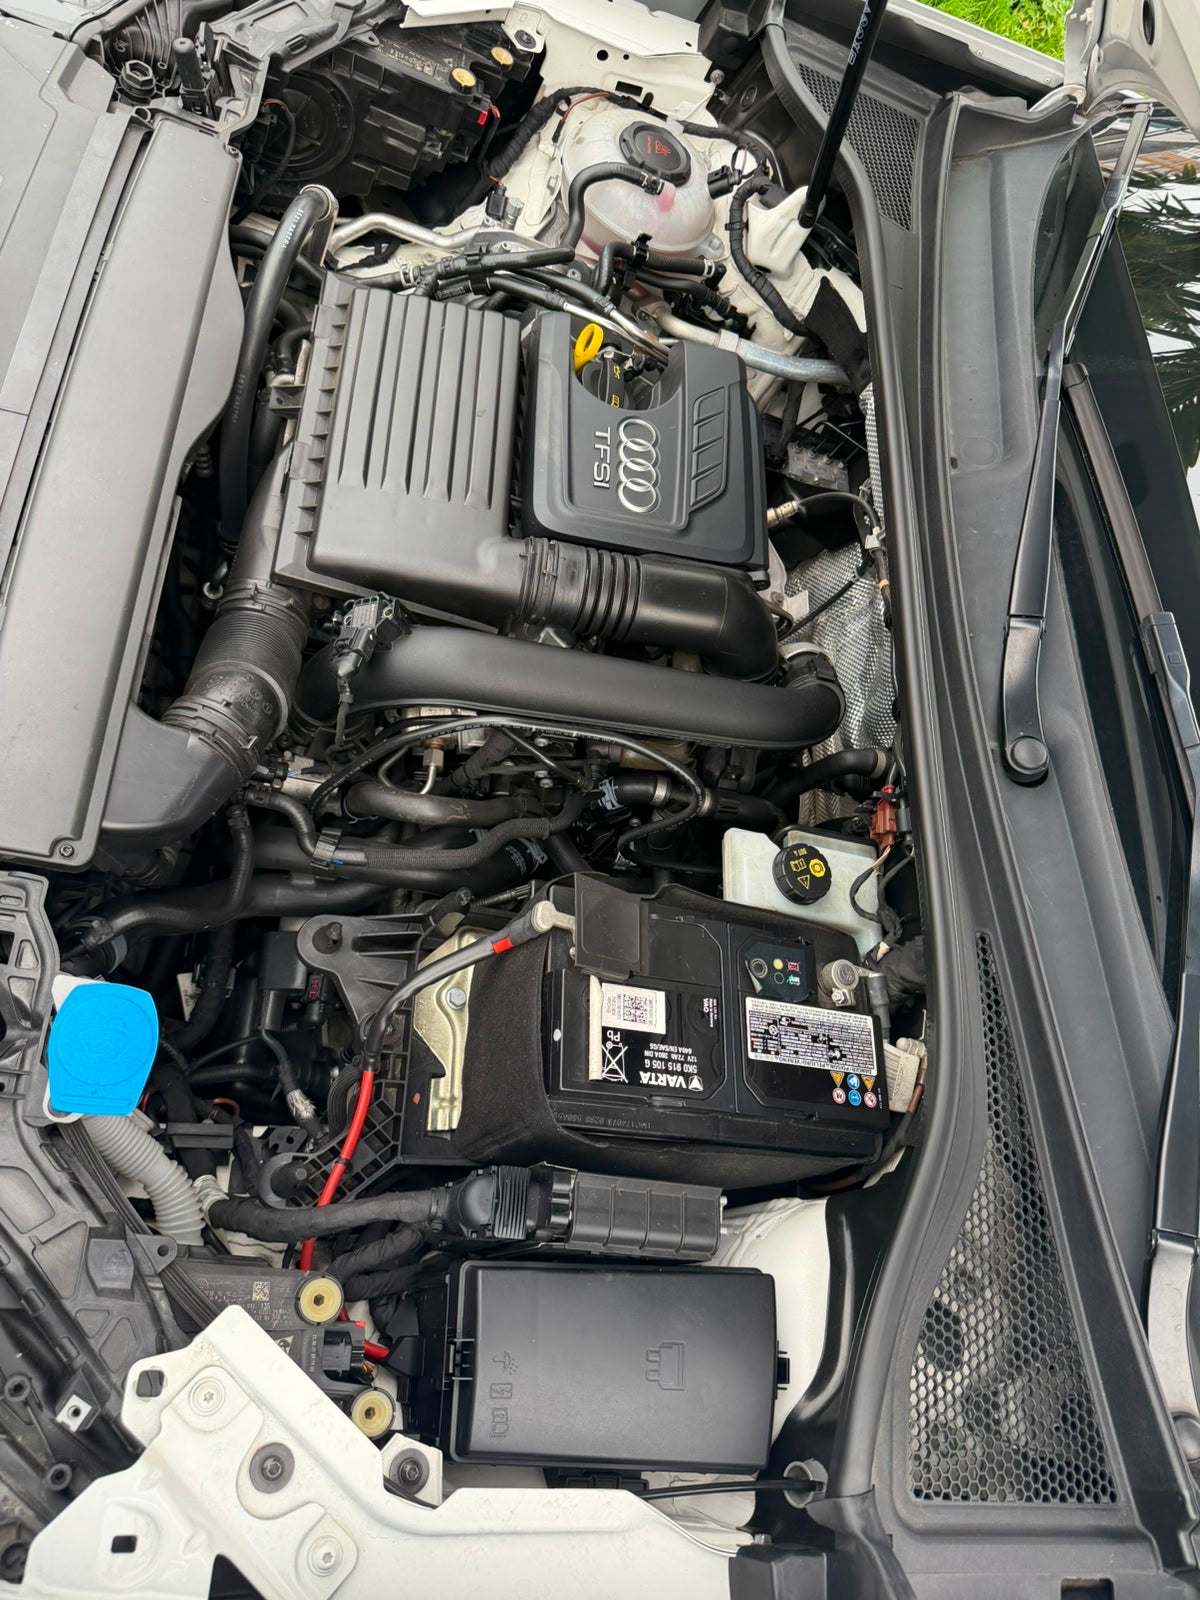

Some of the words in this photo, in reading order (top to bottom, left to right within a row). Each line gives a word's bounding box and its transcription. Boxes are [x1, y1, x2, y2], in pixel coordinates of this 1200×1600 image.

[593, 427, 610, 488] TFSI
[607, 1030, 620, 1041] Pb
[671, 1053, 685, 1061] 72Ah
[644, 1059, 650, 1068] G
[652, 1060, 665, 1070] 105
[668, 1062, 681, 1071] 915
[683, 1063, 698, 1073] 5K0
[639, 1071, 687, 1089] VARTA
